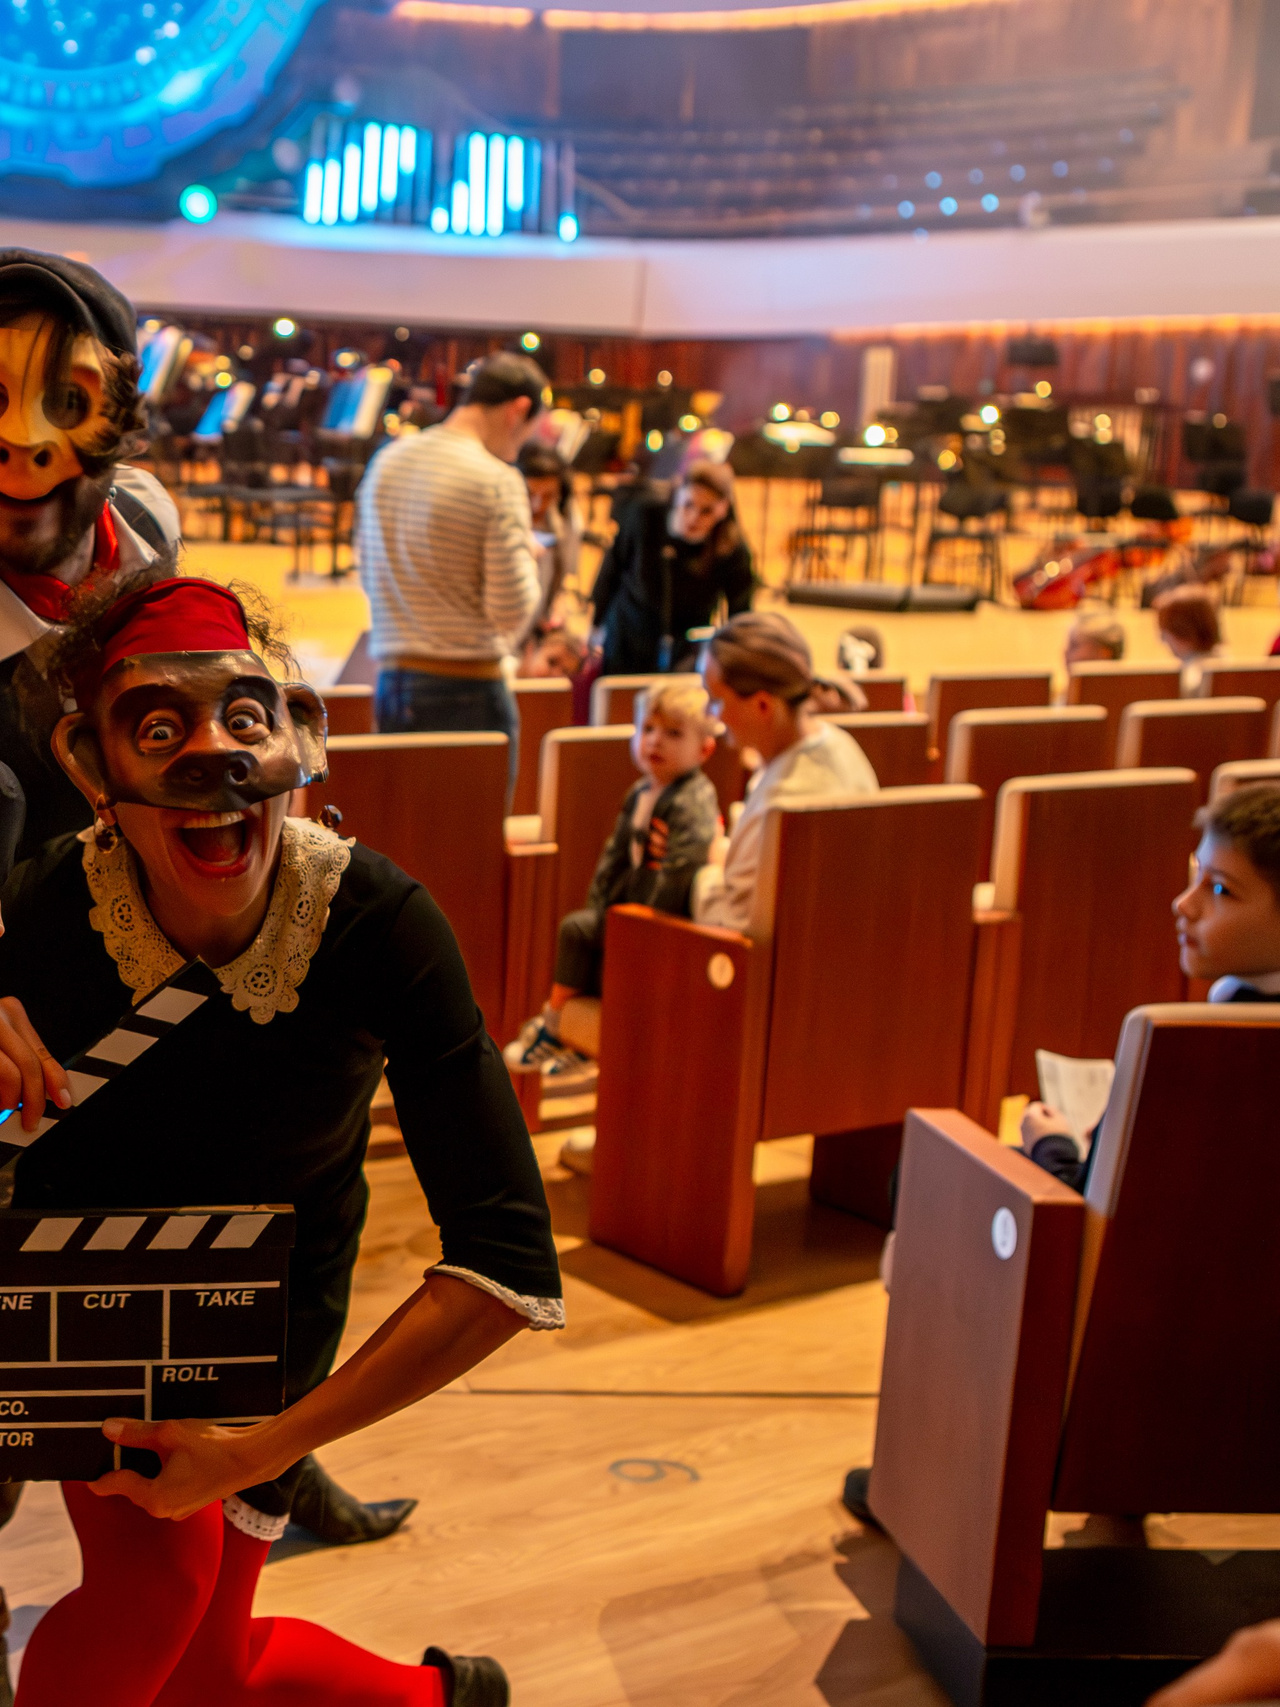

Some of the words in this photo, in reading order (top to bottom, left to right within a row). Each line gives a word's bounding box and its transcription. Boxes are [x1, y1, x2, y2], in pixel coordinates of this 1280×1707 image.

[83, 1293, 131, 1308] CUT
[196, 1291, 255, 1306] TAKE
[162, 1367, 218, 1382] ROLL
